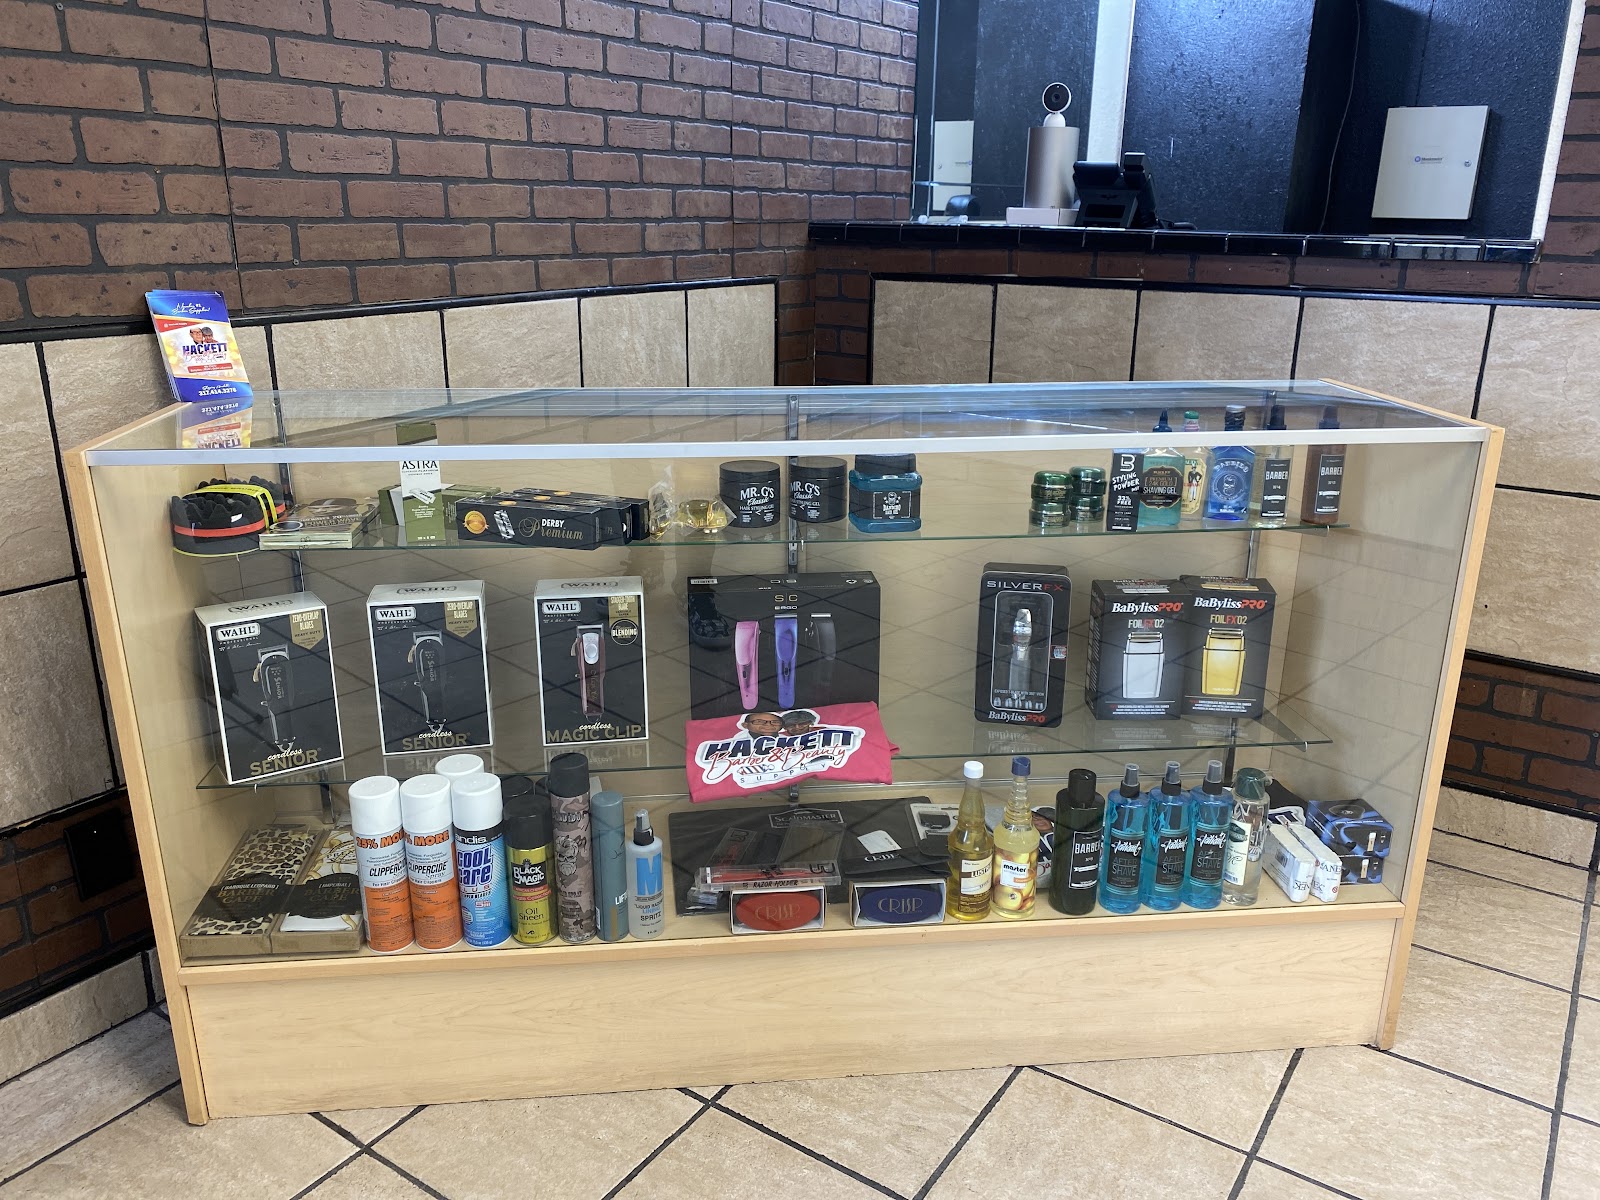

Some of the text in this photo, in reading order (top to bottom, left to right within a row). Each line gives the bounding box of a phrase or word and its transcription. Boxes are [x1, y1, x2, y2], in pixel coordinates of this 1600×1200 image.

[182, 342, 228, 356] HACKETT
[402, 460, 438, 470] ASTRA
[1320, 466, 1343, 476] BARBER
[1112, 472, 1137, 484] STYLING
[1265, 471, 1288, 480] BARBER
[790, 481, 820, 496] MR. G'S
[1114, 478, 1140, 492] POWDER
[1143, 486, 1166, 494] SHAVING
[740, 486, 774, 500] MR. G'S
[519, 516, 584, 540] Premium
[542, 519, 564, 528] DERBY
[986, 580, 1064, 591] SILVERFX
[235, 600, 286, 611] WAHL
[1112, 602, 1184, 615] BaBylissPRO
[1194, 598, 1267, 610] BaBylissPRO
[379, 610, 411, 618] WAHL
[220, 626, 256, 638] WAHL
[612, 629, 638, 637] BLENDING
[579, 722, 612, 731] cordless
[418, 730, 452, 738] cordless
[546, 724, 642, 742] MAGIC CLIP
[402, 734, 467, 750] SENIOR
[705, 730, 854, 760] HACKETT
[267, 748, 303, 761] cordless
[250, 750, 319, 776] SENIOR
[706, 749, 768, 780] Barber
[781, 744, 846, 772] Beauty
[414, 830, 450, 846] MORE
[455, 834, 487, 844] andis
[864, 853, 900, 862] CRISP
[1197, 858, 1220, 868] SHAVE
[408, 862, 447, 874] CLIPPERCIDE
[513, 866, 542, 879] BLACK
[1003, 864, 1026, 872] master
[1112, 865, 1136, 876] SHAVE
[514, 872, 544, 885] MAGIC
[217, 889, 275, 898] BARBER
[878, 898, 923, 914] CRISP
[640, 910, 662, 921] SPRITZ
[755, 904, 800, 922] CRISP
